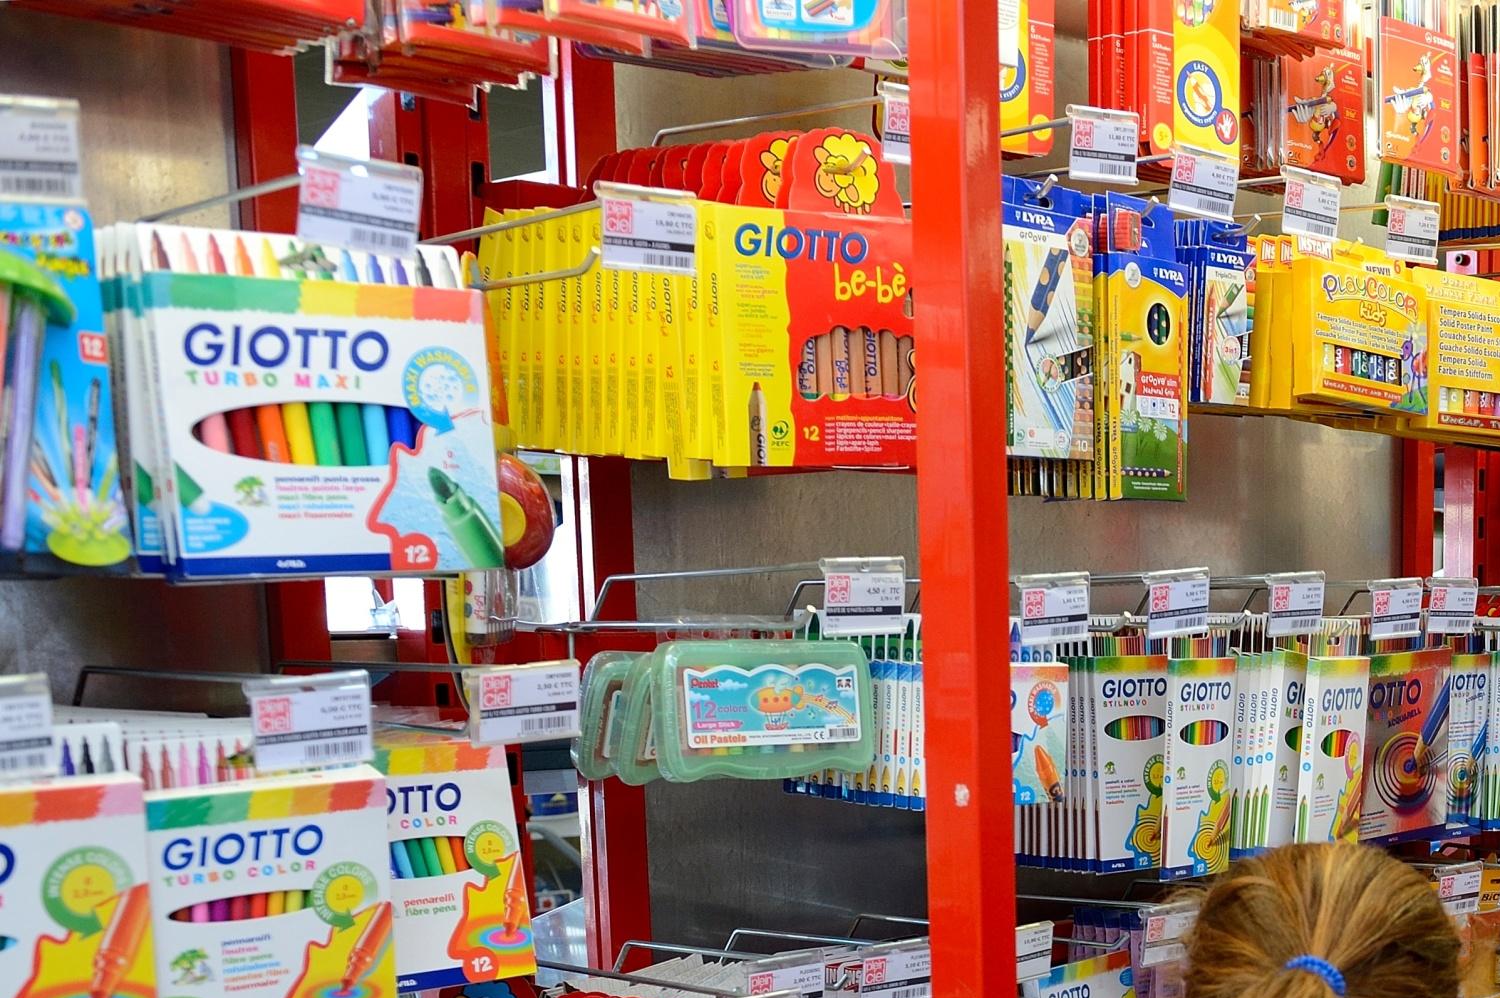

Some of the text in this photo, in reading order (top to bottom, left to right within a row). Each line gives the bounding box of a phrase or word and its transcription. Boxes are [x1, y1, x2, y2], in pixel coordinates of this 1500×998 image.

[1193, 63, 1208, 72] EASY
[1022, 211, 1054, 228] LYRA
[734, 223, 868, 264] GIOTTO
[1216, 252, 1245, 268] LYRA
[834, 262, 906, 304] be-bè
[1158, 268, 1185, 284] LYRA
[1359, 302, 1387, 327] kids
[1439, 318, 1493, 334] Solid Poster Paint
[1439, 330, 1467, 341] Gouache
[1468, 333, 1486, 344] Solide
[1487, 338, 1494, 346] en
[183, 322, 389, 372] GIOTTO
[185, 370, 362, 390] TURBO MAXI
[1438, 366, 1493, 380] Farbe in Stiftform
[1142, 387, 1175, 399] Natural Grip
[1441, 415, 1484, 427] UNCAP,
[803, 427, 820, 441] 12
[1077, 440, 1088, 452] 10
[404, 544, 430, 564] 12
[690, 678, 719, 688] Pentel
[1102, 678, 1167, 698] GIOTTO
[1181, 681, 1231, 701] GIOTTO
[1103, 699, 1147, 709] STILNOVO
[1322, 687, 1362, 712] GIOTTO
[692, 701, 748, 719] 12 colors
[1180, 704, 1215, 712] STILNOVO
[697, 721, 716, 729] Large
[1321, 714, 1342, 726] MEGA
[693, 735, 747, 744] Oil Pastels
[401, 815, 458, 829] COLOR
[162, 824, 324, 871] GIOTTO
[1138, 857, 1148, 866] 12
[163, 860, 318, 887] TURBO COLOR
[404, 893, 455, 908] pennarelli
[405, 905, 457, 916] fibre pens
[471, 957, 493, 973] 12
